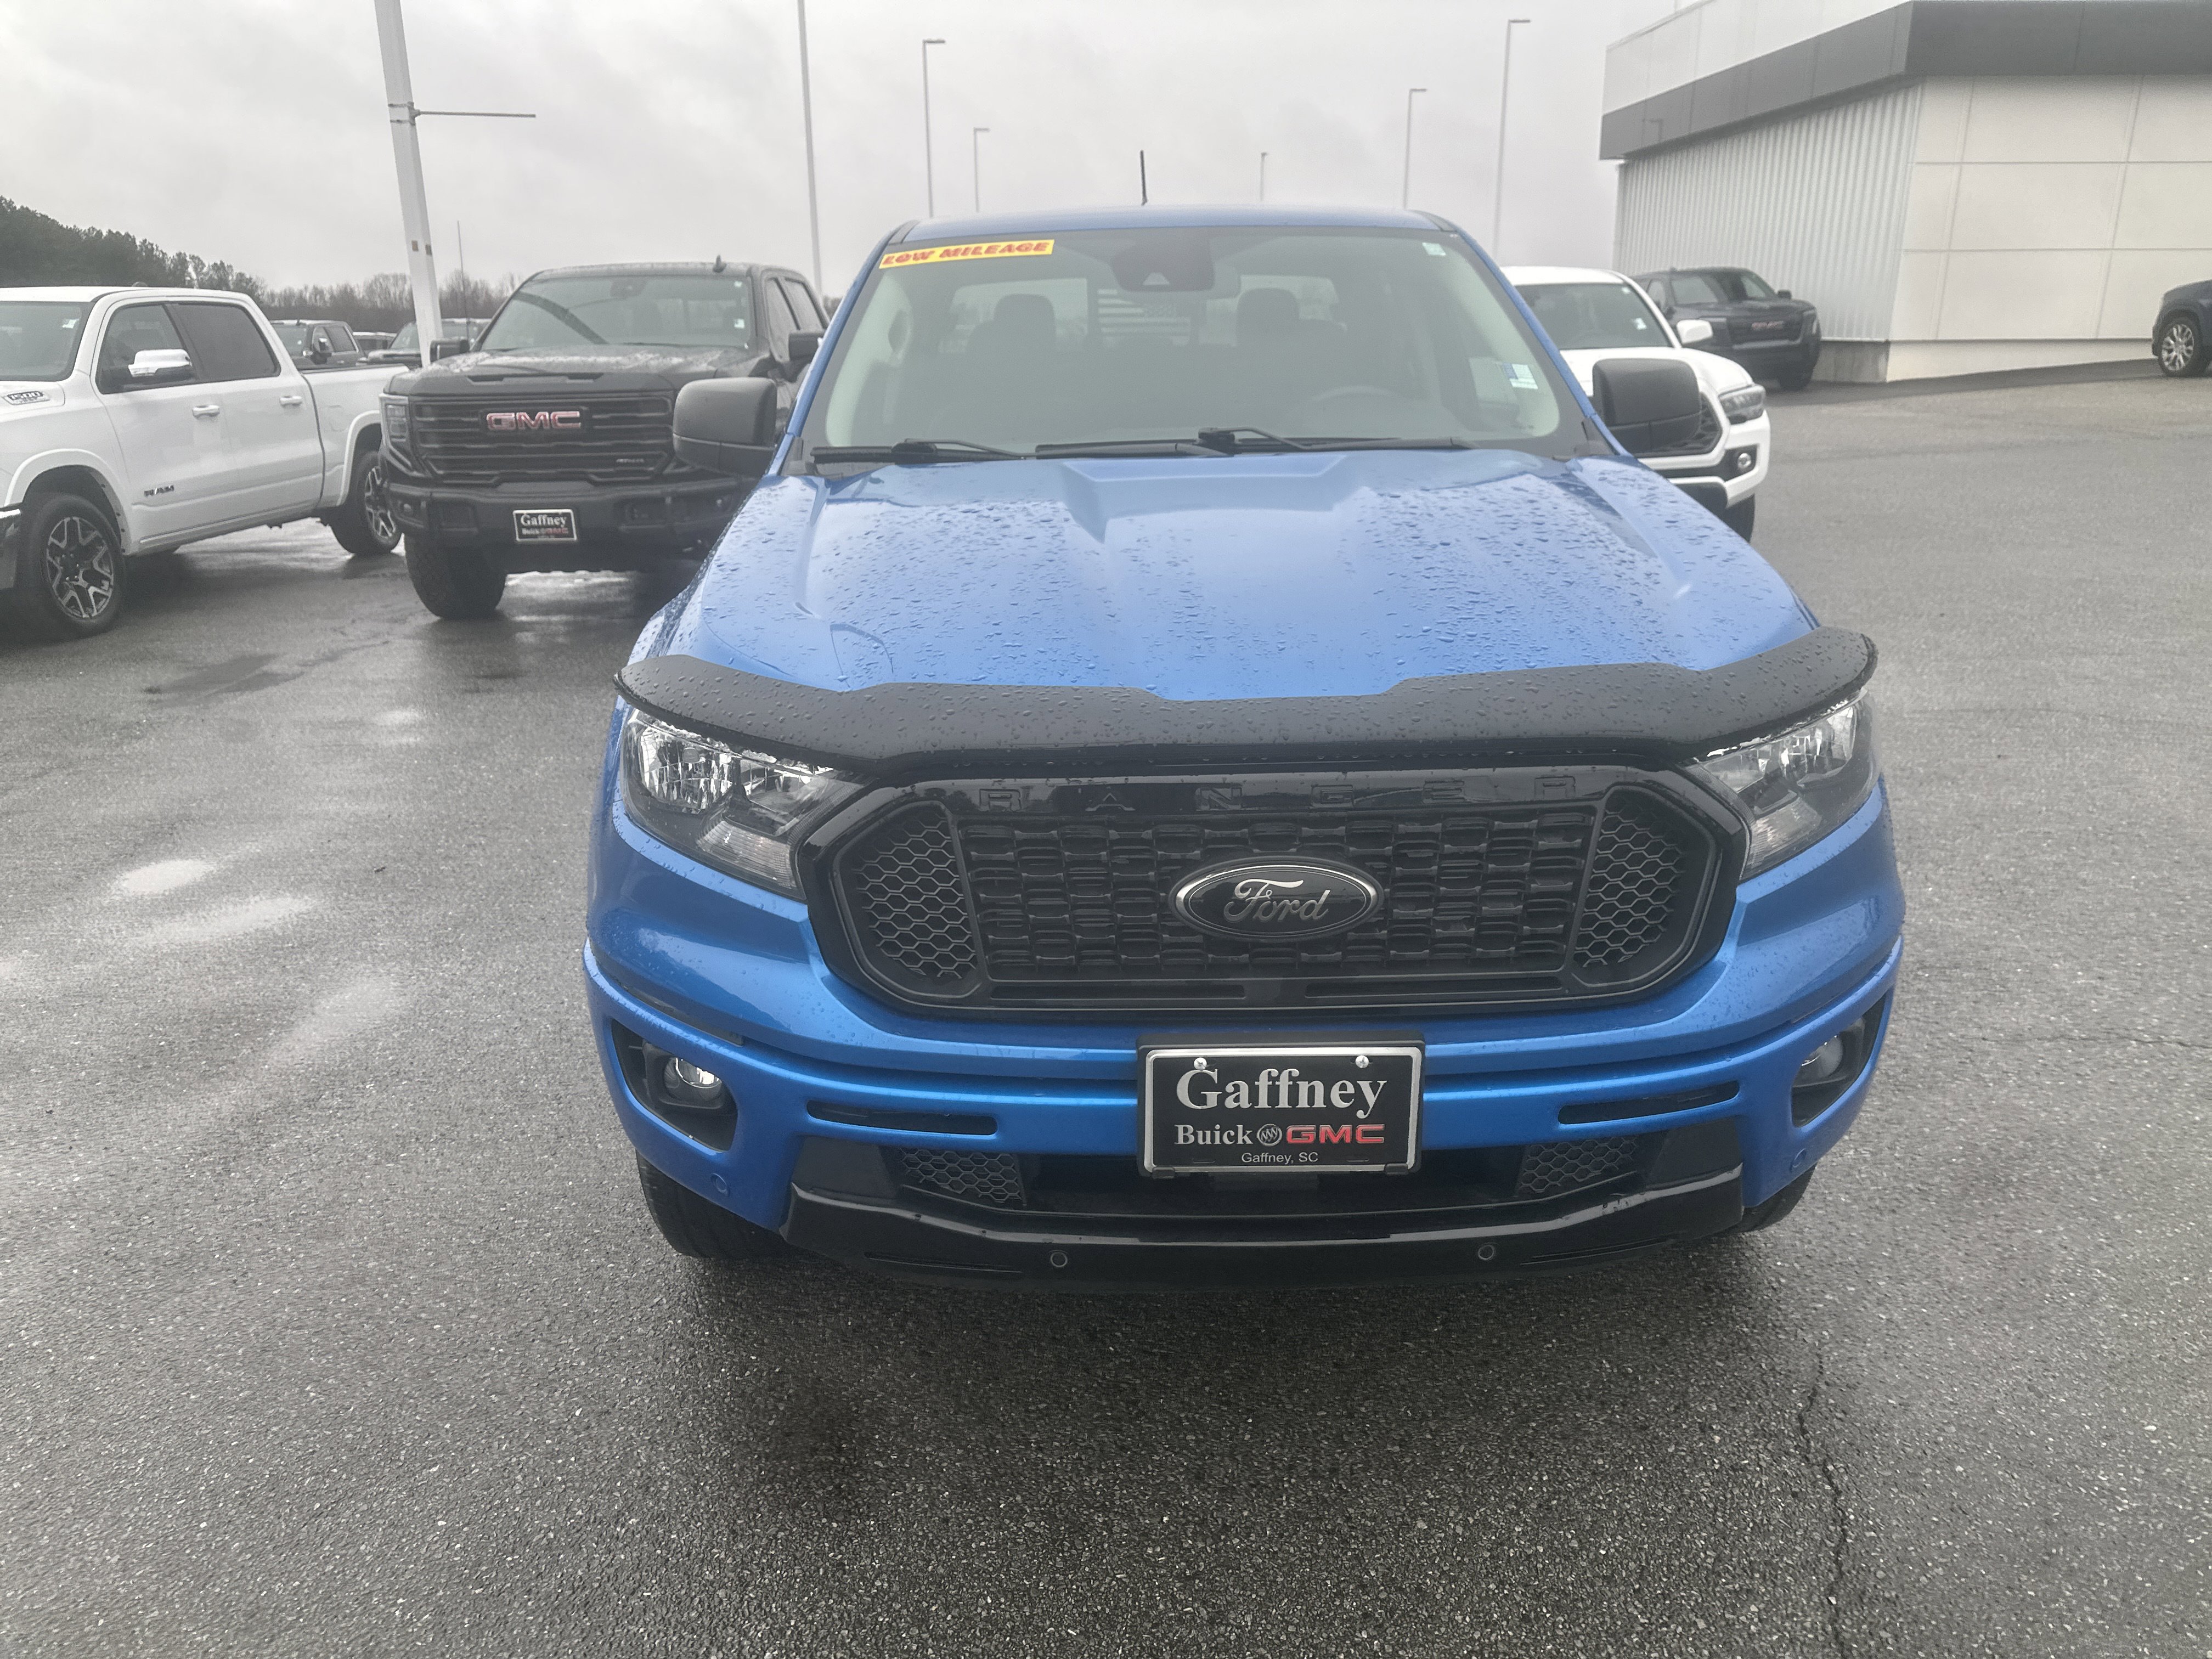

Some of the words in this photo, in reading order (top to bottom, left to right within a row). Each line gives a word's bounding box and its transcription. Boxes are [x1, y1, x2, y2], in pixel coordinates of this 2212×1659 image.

[882, 250, 935, 265] LOW
[939, 242, 1050, 258] MILEAGE
[486, 411, 582, 430] GMC
[520, 514, 567, 527] Gaffney
[1223, 878, 1331, 922] Ford
[1176, 1068, 1387, 1119] Gaffney
[1174, 1124, 1254, 1145] Buick
[1286, 1124, 1385, 1144] GMC
[1241, 1152, 1295, 1165] Gaffney,
[1299, 1152, 1319, 1163] SC
